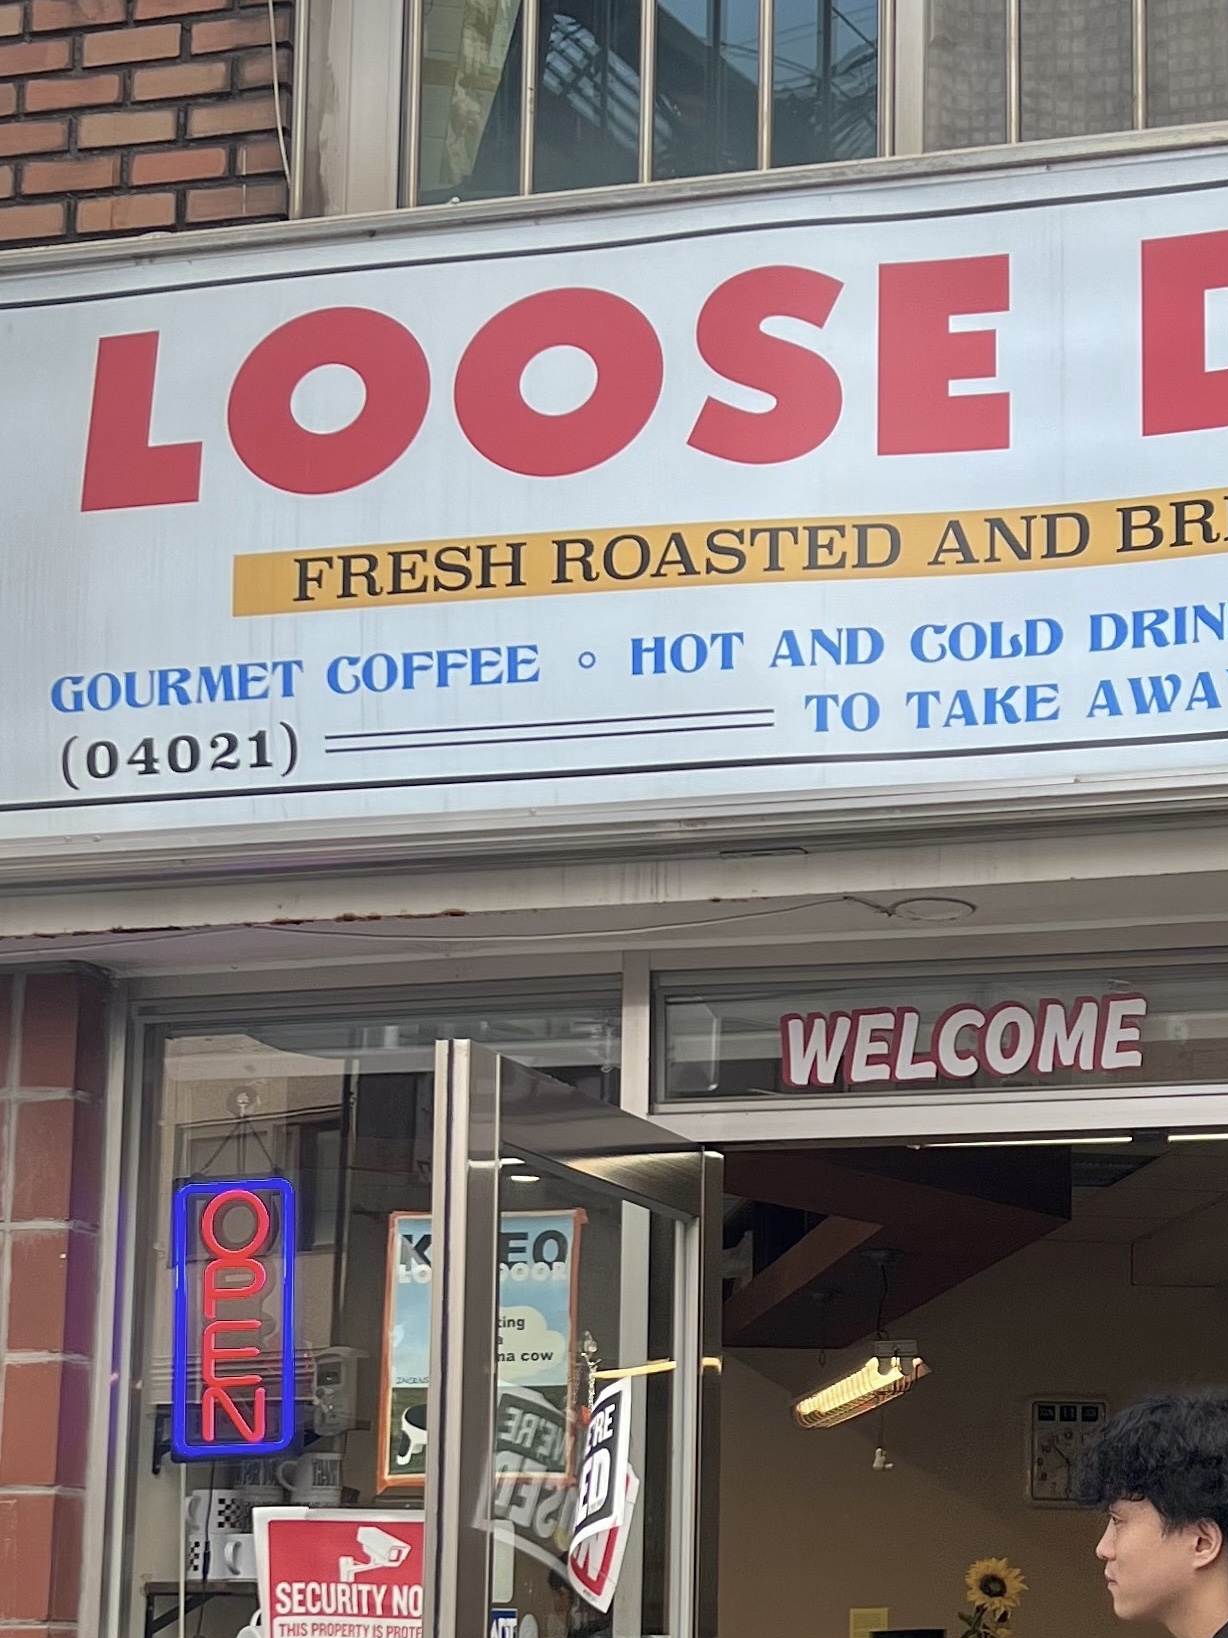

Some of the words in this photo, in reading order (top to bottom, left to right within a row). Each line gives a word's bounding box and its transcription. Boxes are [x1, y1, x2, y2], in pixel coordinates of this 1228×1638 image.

[82, 256, 1009, 511] LOOSE
[292, 541, 527, 608] FRESH
[551, 523, 901, 584] ROASTED
[928, 512, 1090, 565] AND
[51, 660, 303, 713] GOURMET
[326, 645, 539, 694] COFFEE
[631, 632, 744, 676] HOT
[771, 626, 884, 667] AND
[910, 618, 1063, 663] COLD
[804, 692, 880, 733] TO
[906, 683, 1060, 730] TAKE
[62, 721, 298, 791] (04021)
[780, 993, 1148, 1087] WELCOME
[201, 1188, 270, 1444] OPEN
[520, 1352, 554, 1362] cow
[275, 1581, 388, 1616] SECURITY
[279, 1623, 308, 1637] THIS
[311, 1623, 371, 1638] PROPERTY
[373, 1624, 383, 1638] IS
